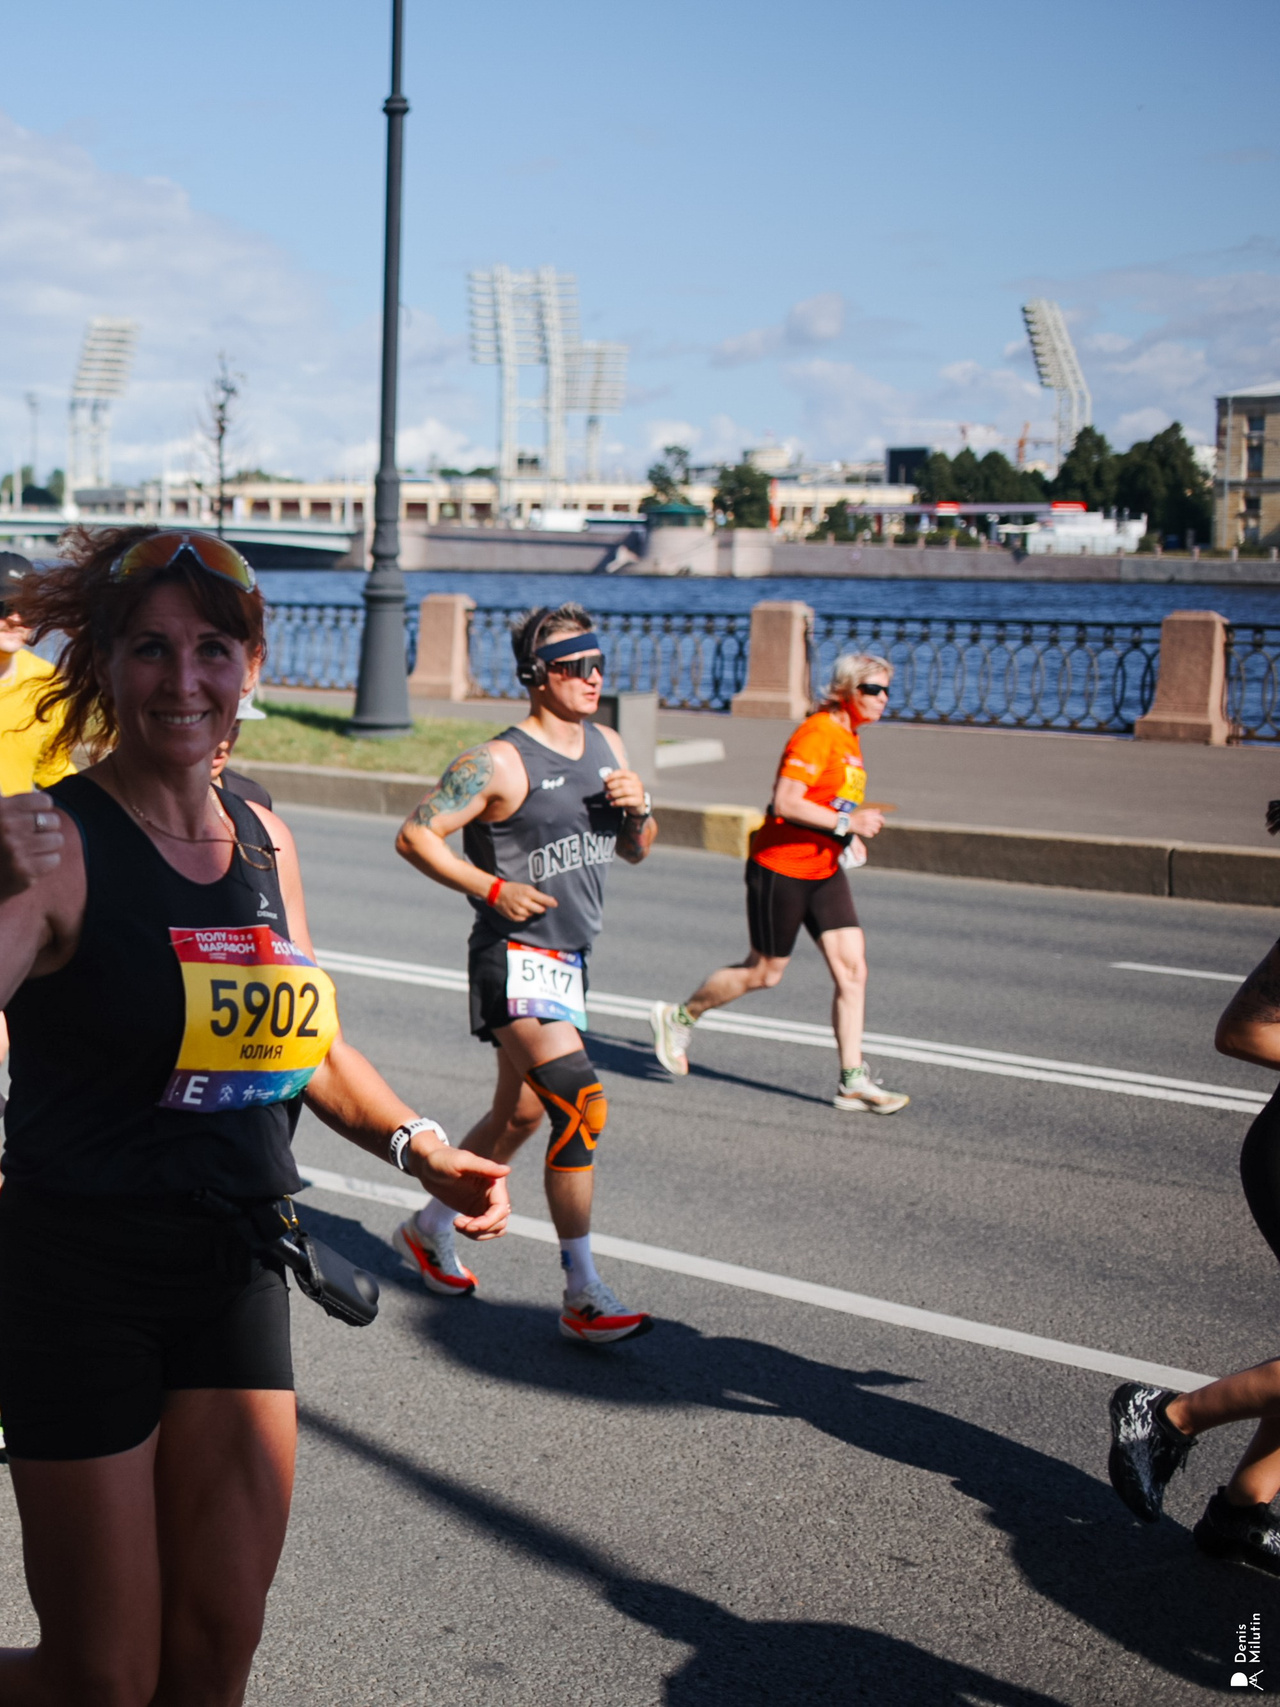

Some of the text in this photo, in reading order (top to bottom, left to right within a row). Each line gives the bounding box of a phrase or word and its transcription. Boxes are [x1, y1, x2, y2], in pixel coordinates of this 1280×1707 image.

[528, 834, 583, 883] ONE
[195, 932, 227, 942] ПОЛУ
[198, 943, 255, 954] МАРАФОН
[522, 959, 573, 994] 5117
[210, 979, 319, 1038] 5902
[240, 1044, 283, 1059] ЮЛИЯ
[182, 1075, 209, 1105] E
